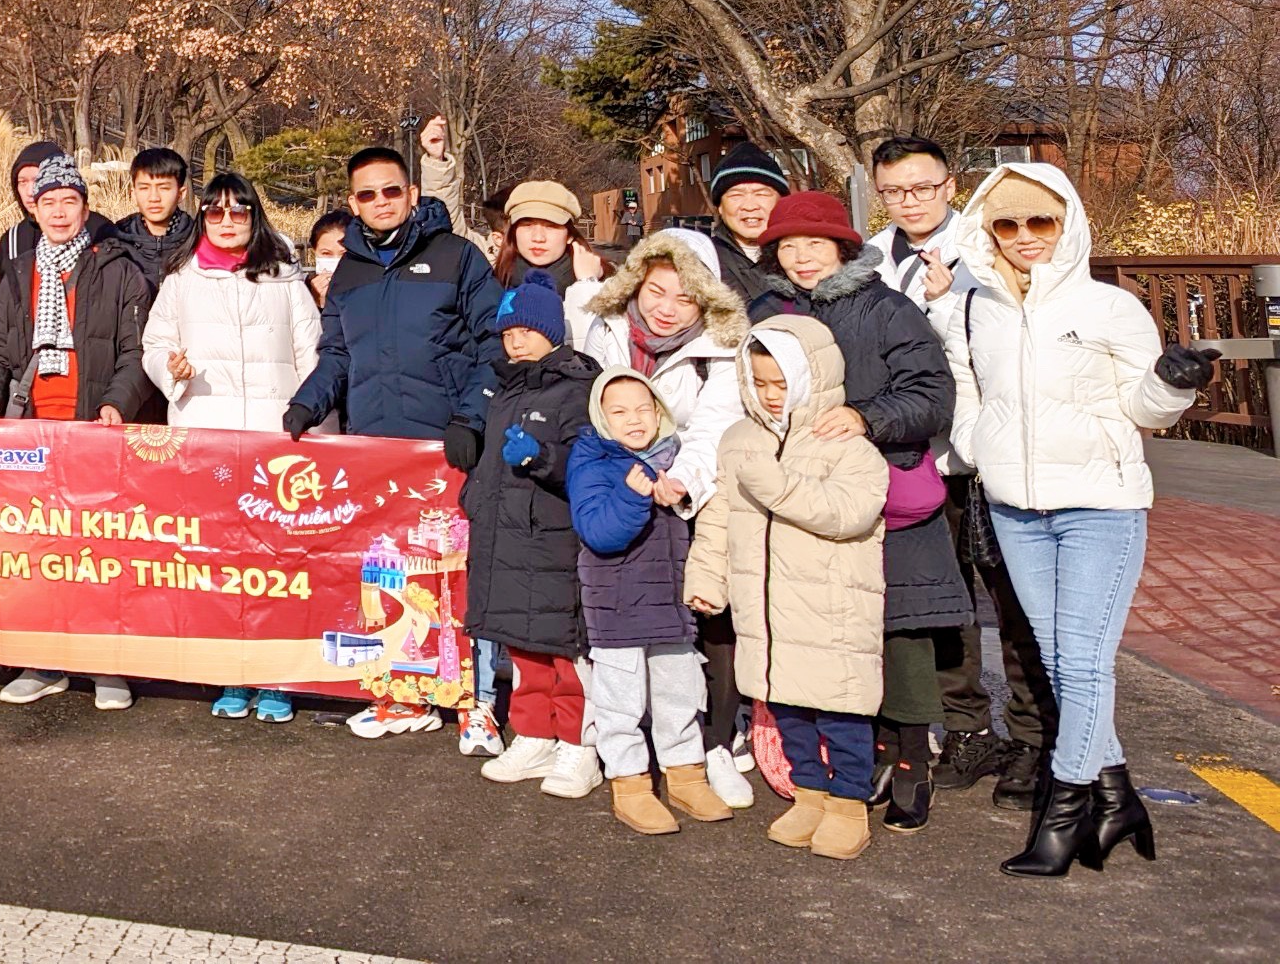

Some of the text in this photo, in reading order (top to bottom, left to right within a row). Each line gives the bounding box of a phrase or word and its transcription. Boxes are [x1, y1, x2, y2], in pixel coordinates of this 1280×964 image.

[267, 454, 327, 512] Tết
[81, 503, 201, 545] KHÁCH
[237, 493, 274, 521] Kết
[268, 510, 295, 528] vạn
[298, 505, 332, 527] niềm
[40, 546, 123, 584] GIÁP
[130, 552, 211, 592] THÌN
[220, 566, 312, 600] 2024
